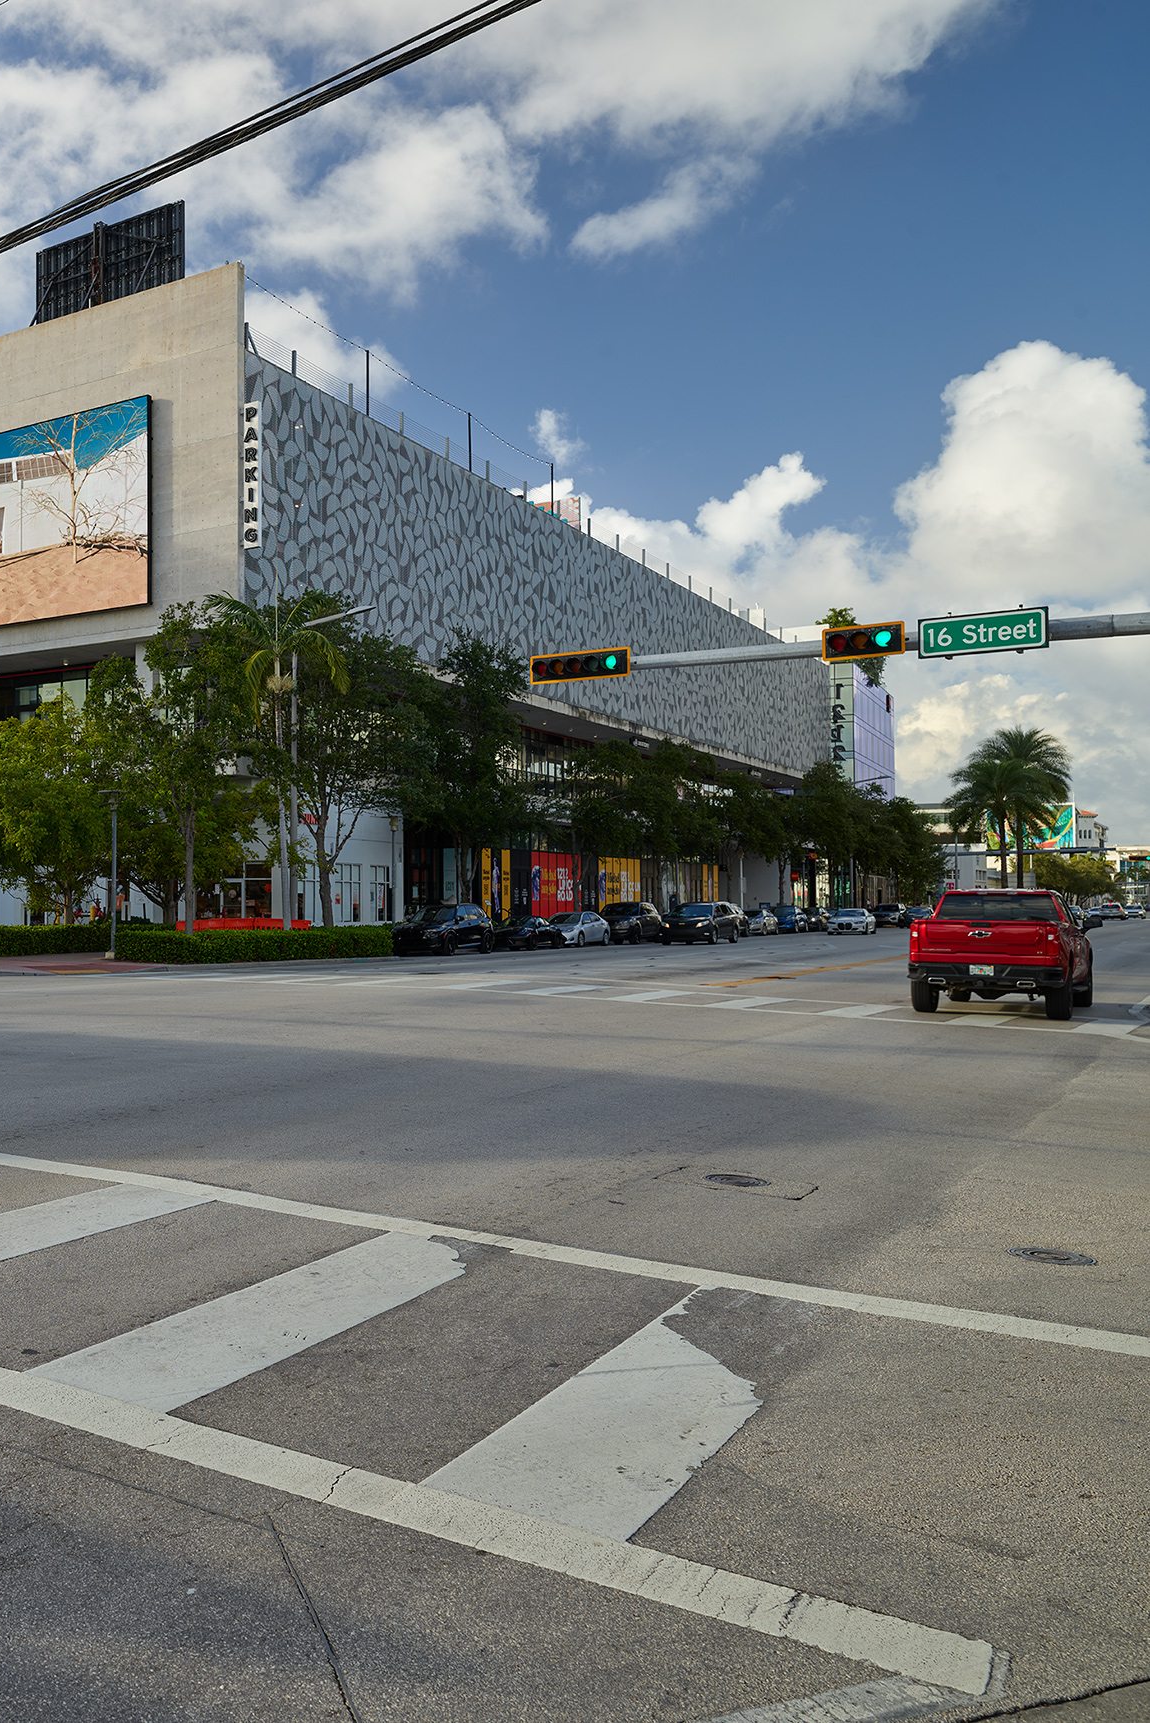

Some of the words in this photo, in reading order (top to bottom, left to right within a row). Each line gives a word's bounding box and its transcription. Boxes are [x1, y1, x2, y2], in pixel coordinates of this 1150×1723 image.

[244, 407, 257, 542] PARKING
[928, 627, 953, 647] 16
[962, 618, 1037, 644] Street
[557, 890, 573, 901] ROAD
